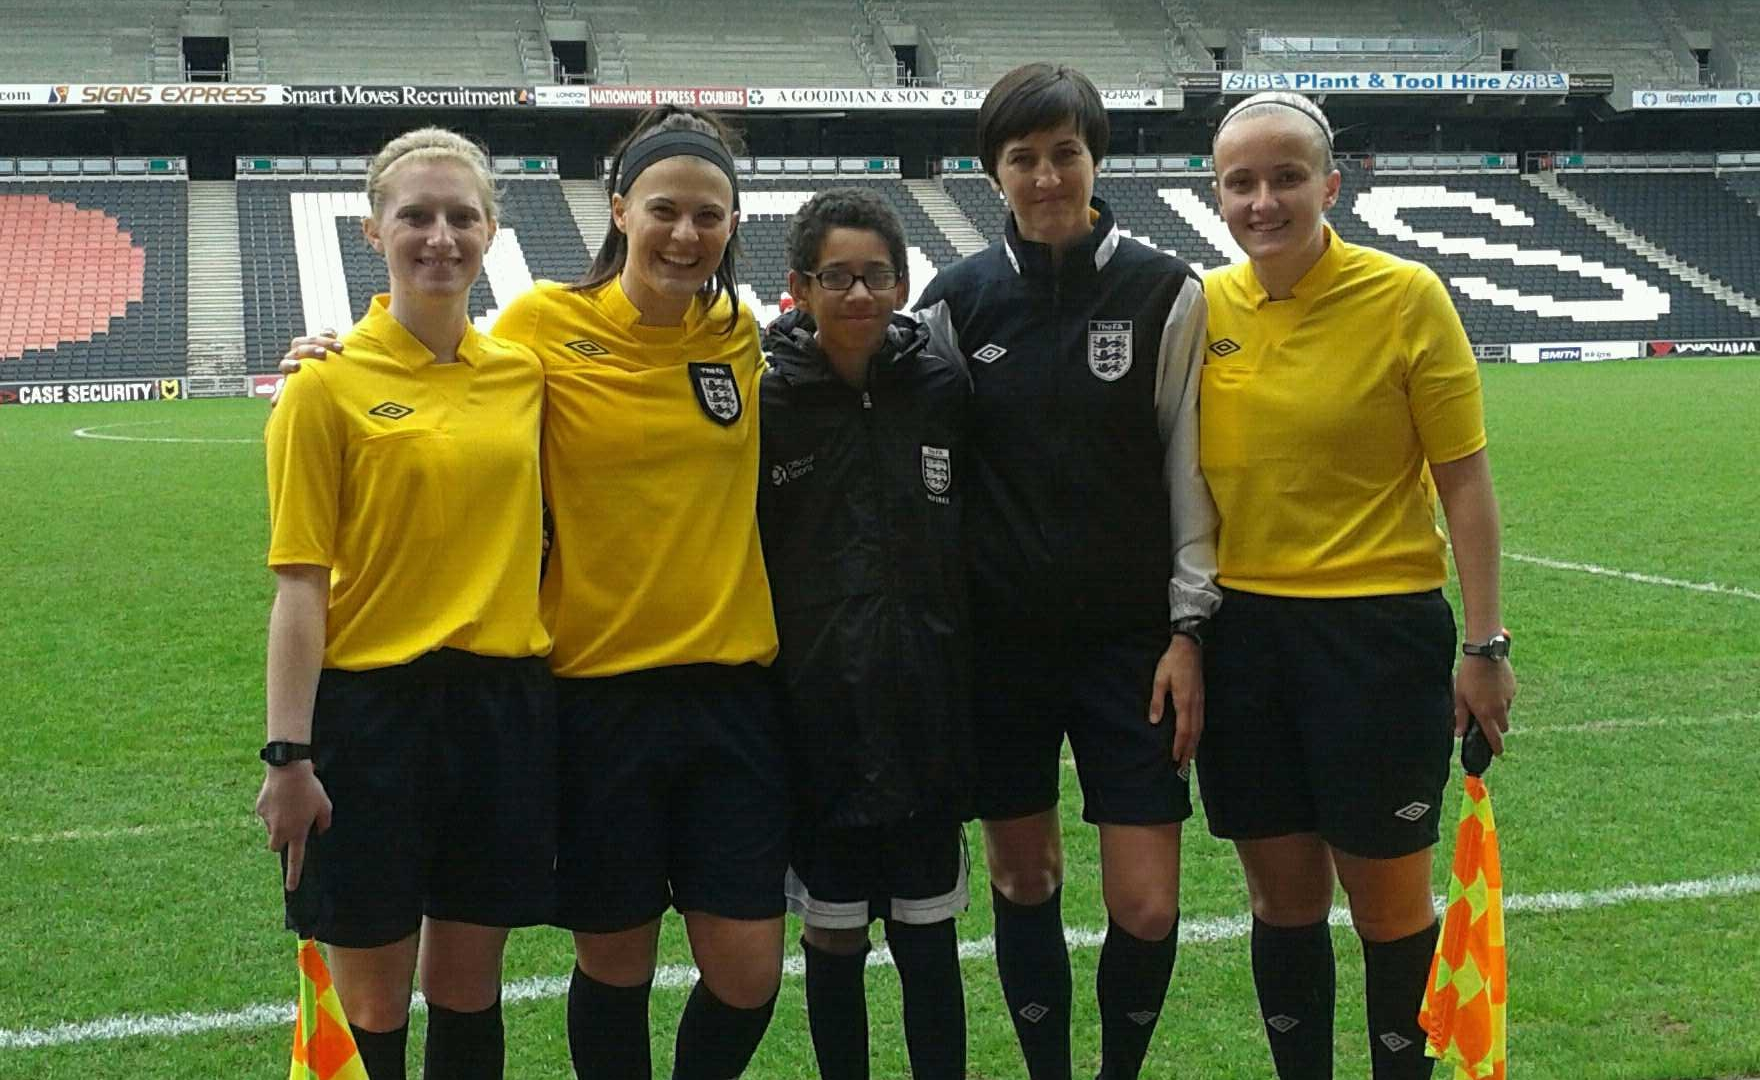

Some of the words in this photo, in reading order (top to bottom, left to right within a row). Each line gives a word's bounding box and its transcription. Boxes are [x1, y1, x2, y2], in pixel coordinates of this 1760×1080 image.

[1295, 74, 1359, 89] Plant
[1367, 74, 1384, 89] &
[1393, 74, 1442, 89] Tool
[1452, 74, 1500, 89] Hire
[82, 86, 152, 103] SIGNS
[161, 86, 267, 103] EXPRESS
[281, 86, 336, 106] Smart
[340, 86, 399, 106] Moves
[402, 86, 517, 106] Recruitment
[591, 90, 652, 105] NATIONWIDE
[655, 90, 697, 105] EXPRESS
[699, 90, 744, 106] COURIERS
[777, 90, 787, 102] A
[792, 90, 876, 103] GOODMAN
[881, 90, 893, 103] &
[897, 90, 930, 102] SON
[1541, 350, 1580, 359] SMITH
[19, 385, 64, 404] CASE
[68, 383, 152, 403] SECURITY
